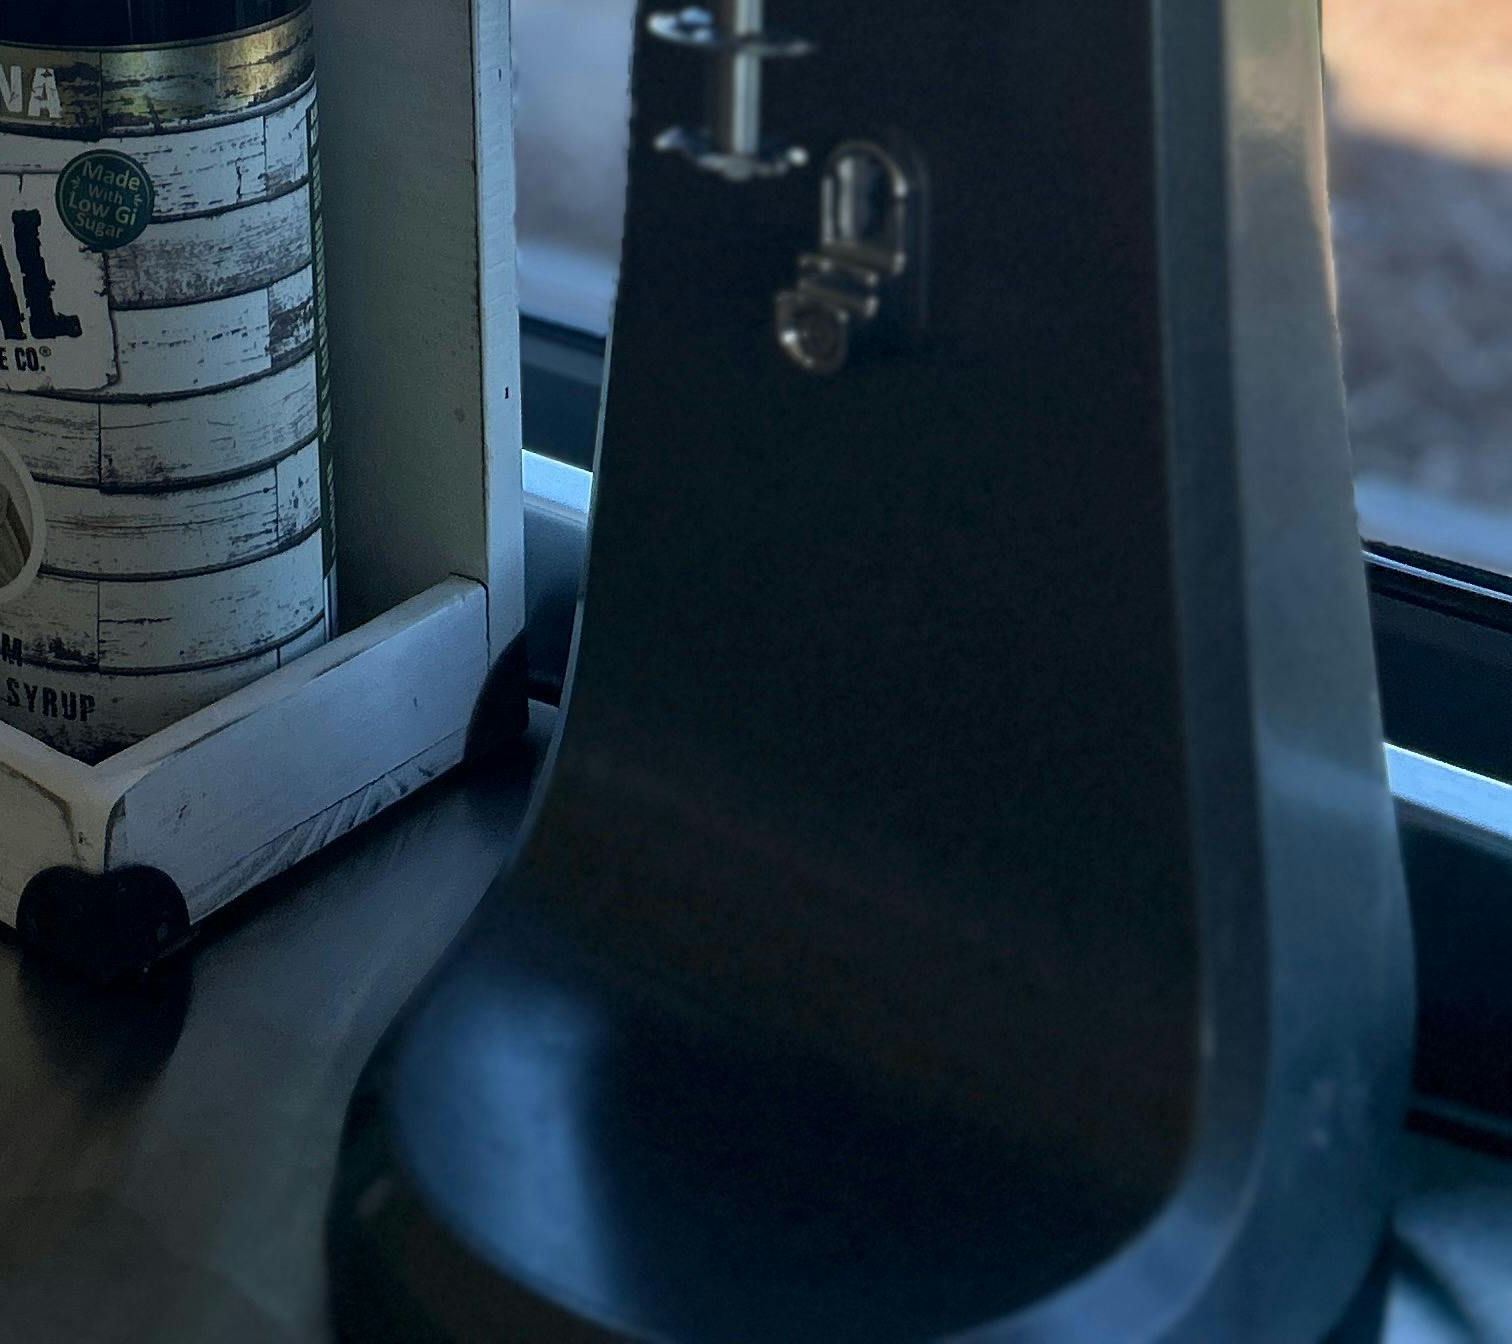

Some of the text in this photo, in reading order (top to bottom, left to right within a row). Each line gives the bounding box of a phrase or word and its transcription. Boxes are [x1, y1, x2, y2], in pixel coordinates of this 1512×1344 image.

[82, 160, 141, 192] Made
[68, 191, 111, 219] Low
[88, 183, 123, 206] With
[74, 211, 125, 241] Sugar
[6, 676, 96, 723] SYRUP
